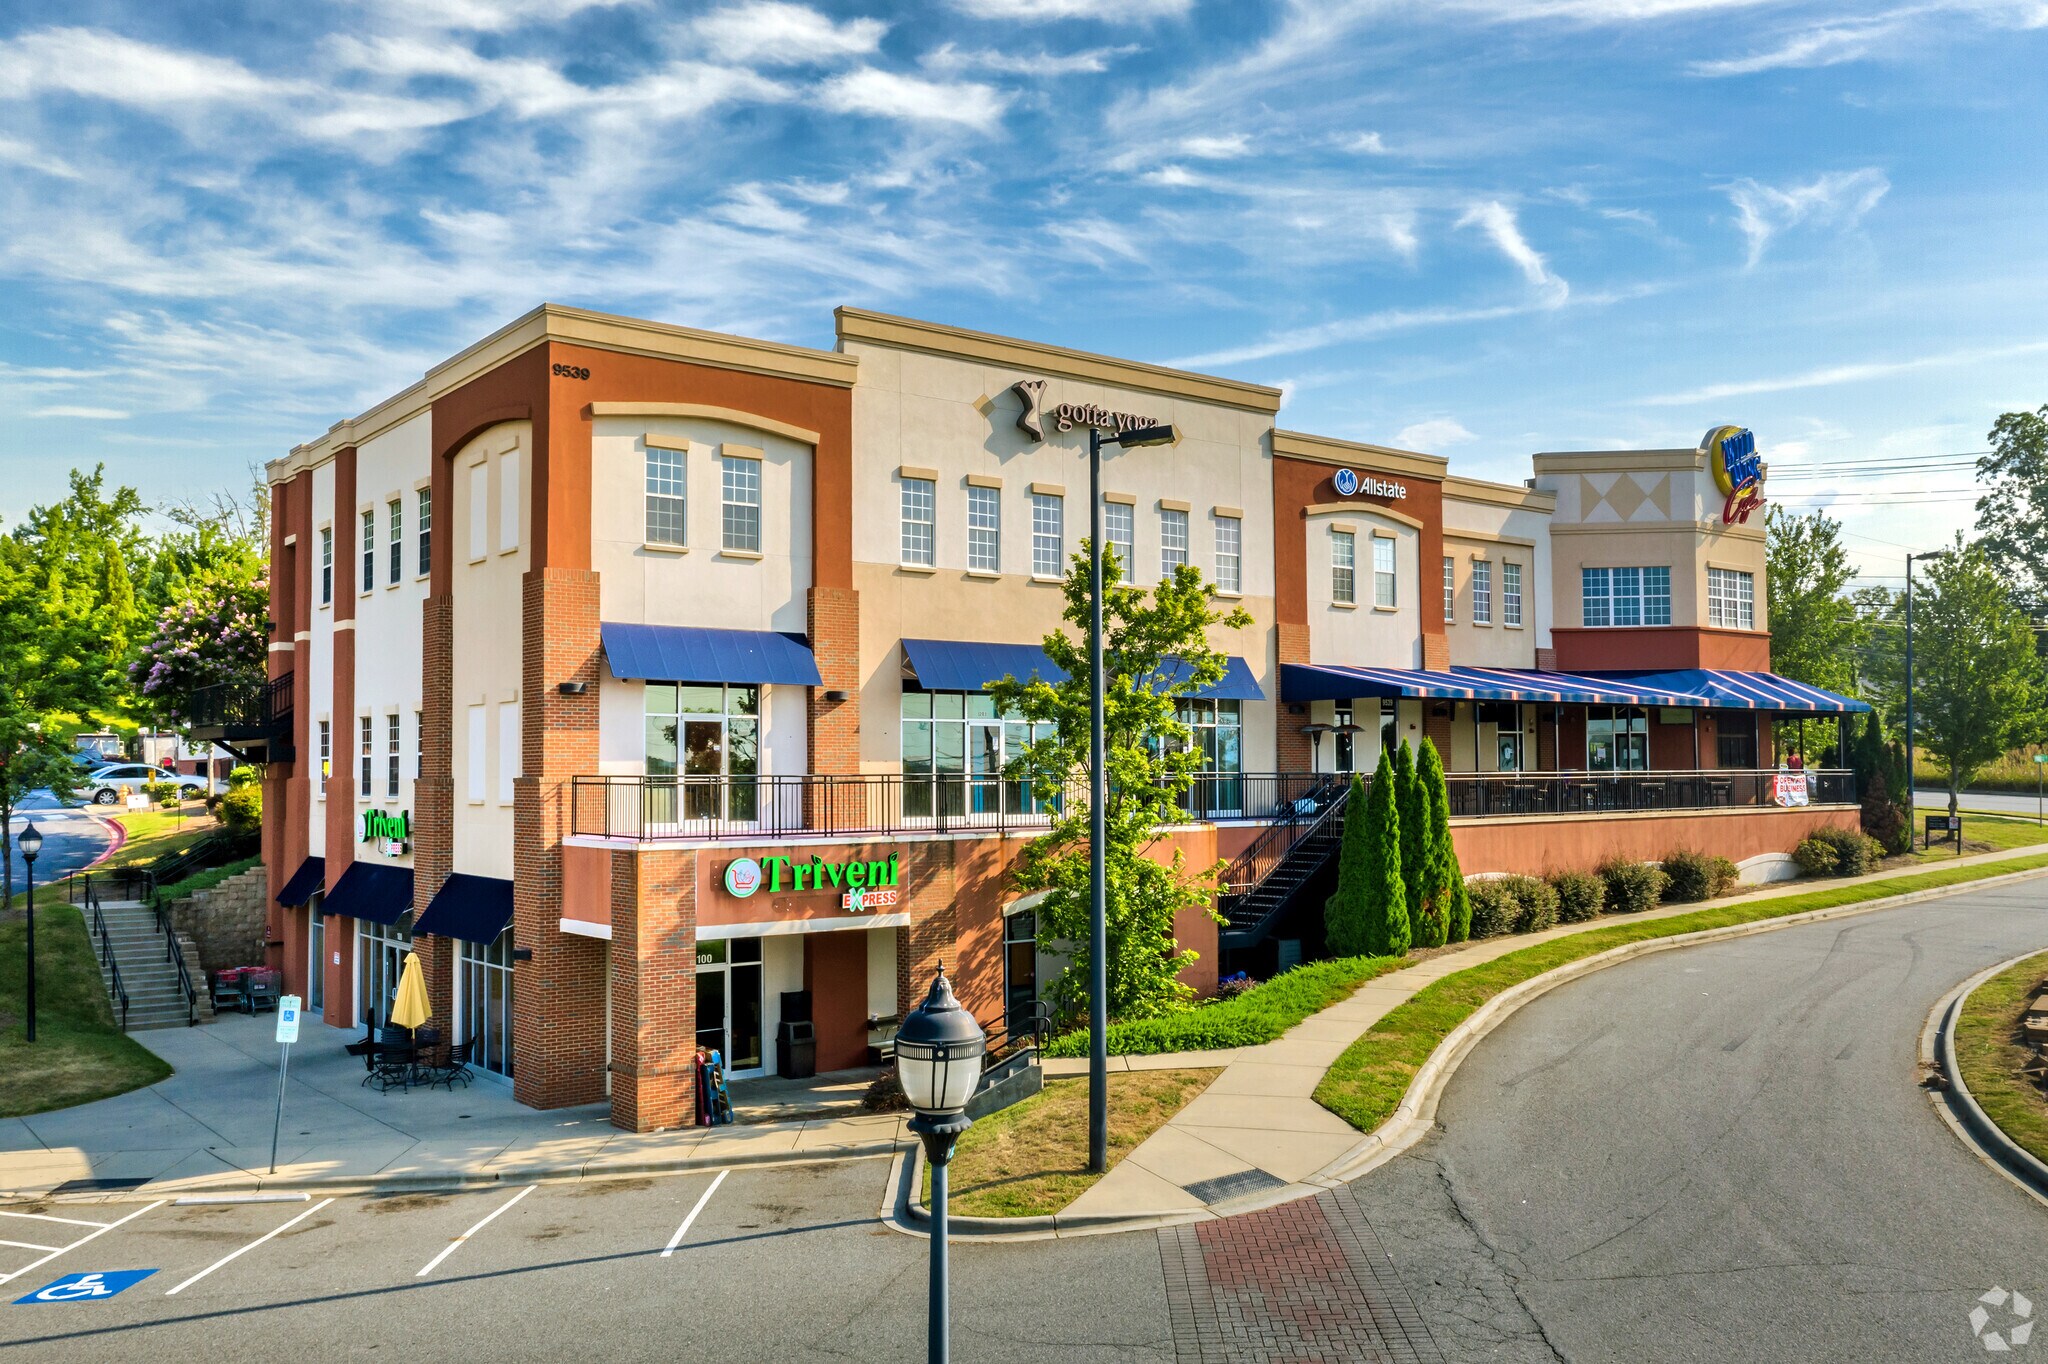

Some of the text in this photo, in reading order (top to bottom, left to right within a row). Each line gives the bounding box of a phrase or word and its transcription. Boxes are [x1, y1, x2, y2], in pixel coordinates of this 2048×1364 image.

[552, 363, 590, 380] 9539
[1057, 402, 1111, 432] gotta
[1359, 476, 1407, 499] Allstate
[366, 809, 406, 839] Triveni
[761, 851, 899, 893] Triveni
[843, 887, 897, 912] EXPRESS
[696, 953, 713, 964] 100
